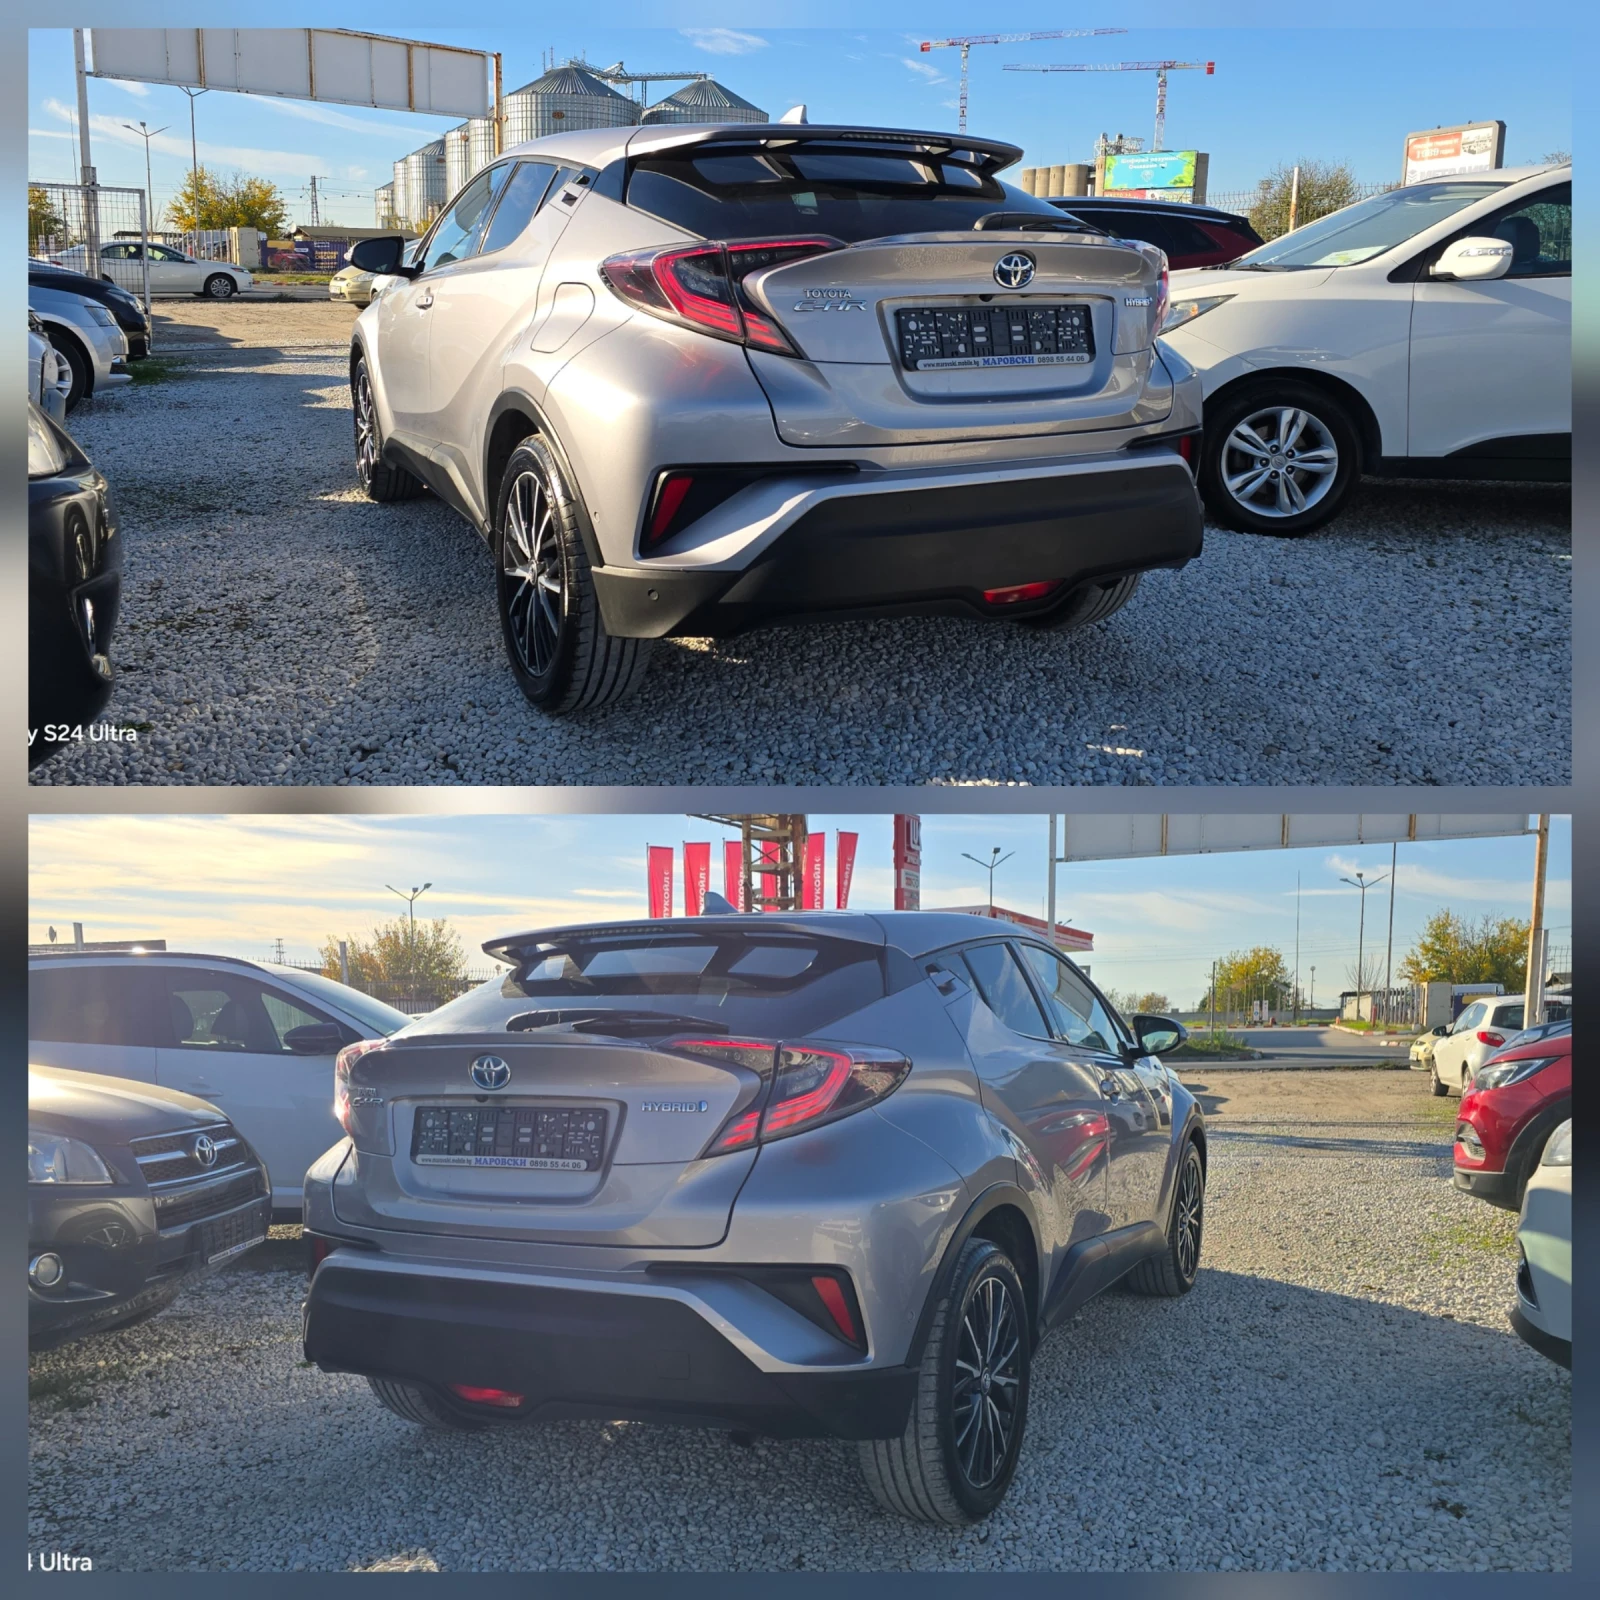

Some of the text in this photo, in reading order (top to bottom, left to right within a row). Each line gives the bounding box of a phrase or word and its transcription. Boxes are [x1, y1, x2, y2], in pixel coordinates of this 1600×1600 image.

[803, 288, 852, 298] TOYOTA
[793, 300, 868, 312] C-HR
[813, 863, 821, 909] ЛУКОЙЛ
[641, 1102, 696, 1112] HYBRID
[561, 1161, 570, 1169] 44
[571, 1161, 582, 1169] 06
